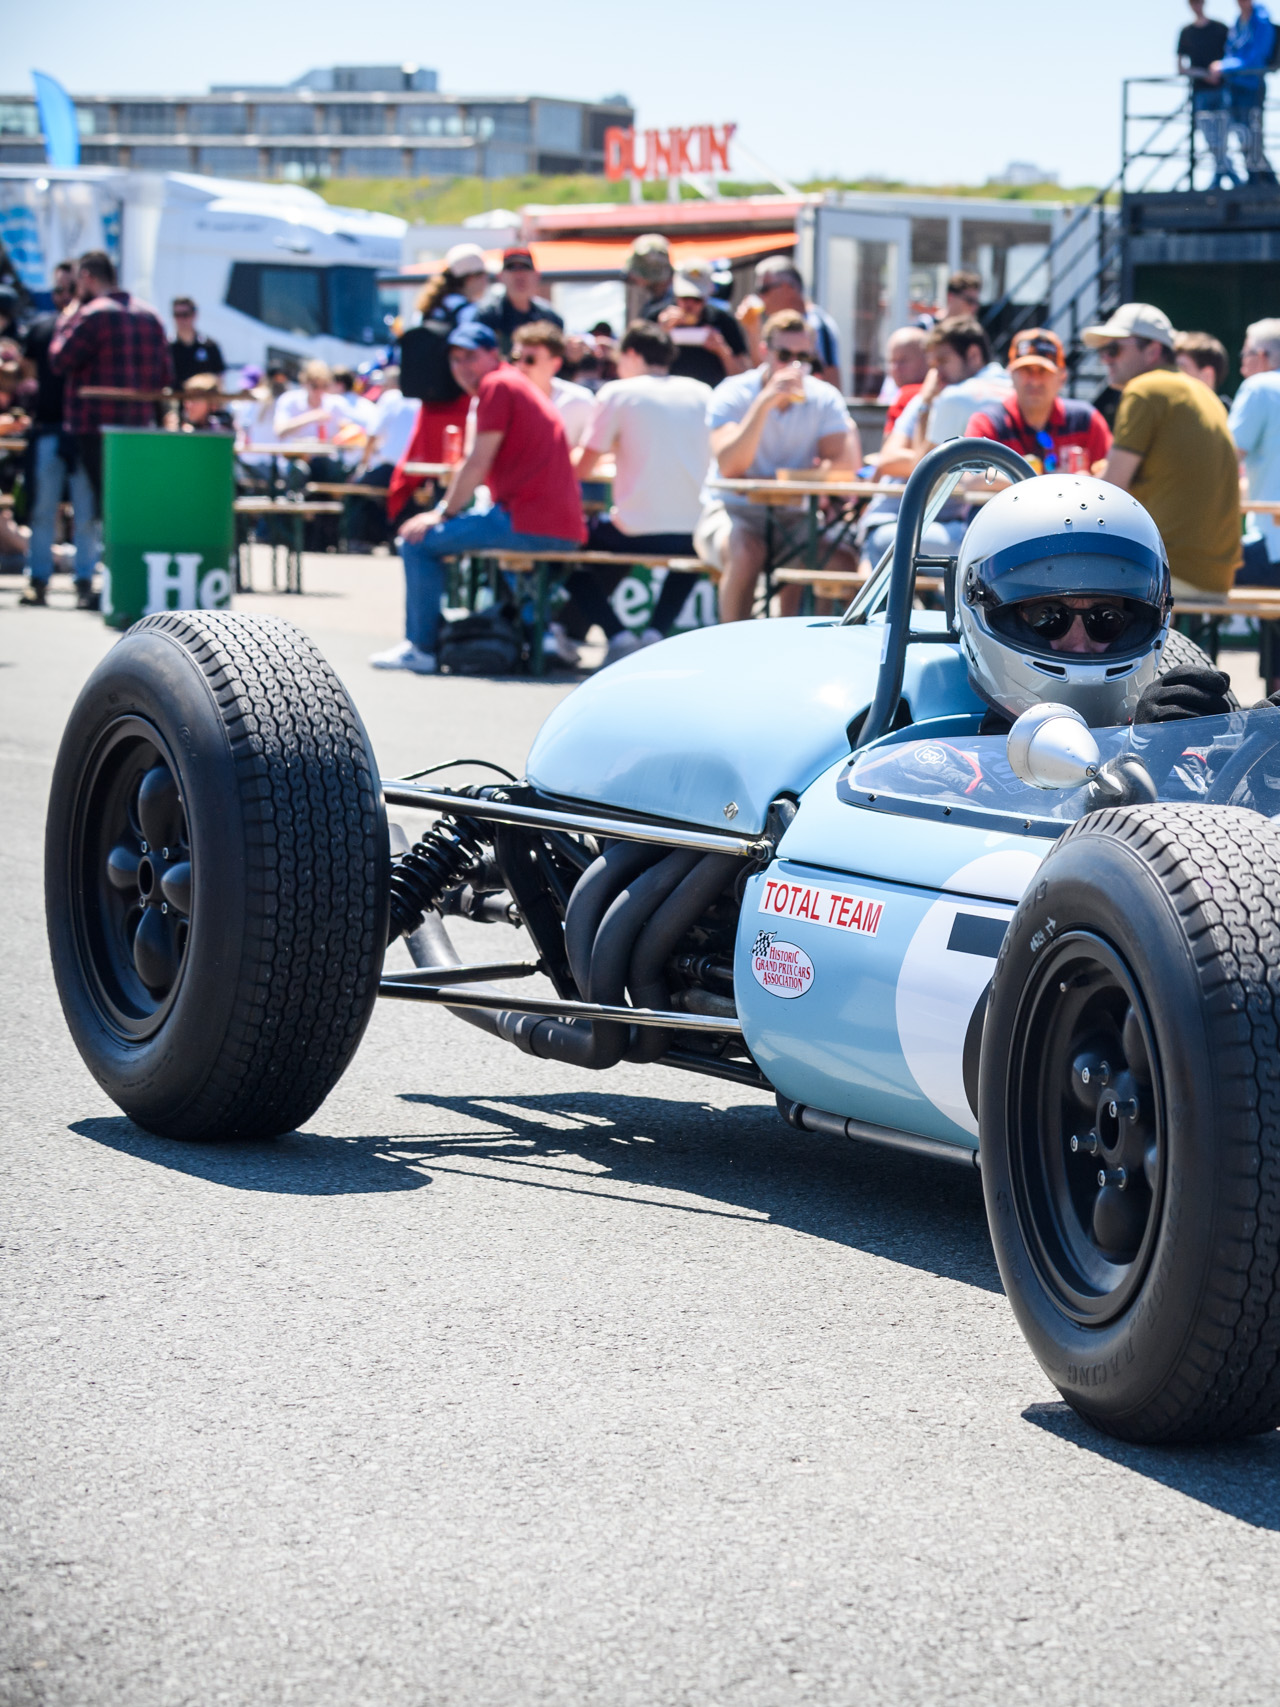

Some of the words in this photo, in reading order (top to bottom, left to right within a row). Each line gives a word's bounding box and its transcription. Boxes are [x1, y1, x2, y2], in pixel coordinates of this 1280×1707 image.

[765, 881, 820, 921] TOTAL
[828, 894, 883, 934] TEAM
[769, 946, 800, 965] HISTORIC
[755, 957, 778, 973] GRAND
[778, 963, 793, 976] PRIX
[793, 966, 811, 980] CARS
[763, 971, 803, 992] ASSOCIATION
